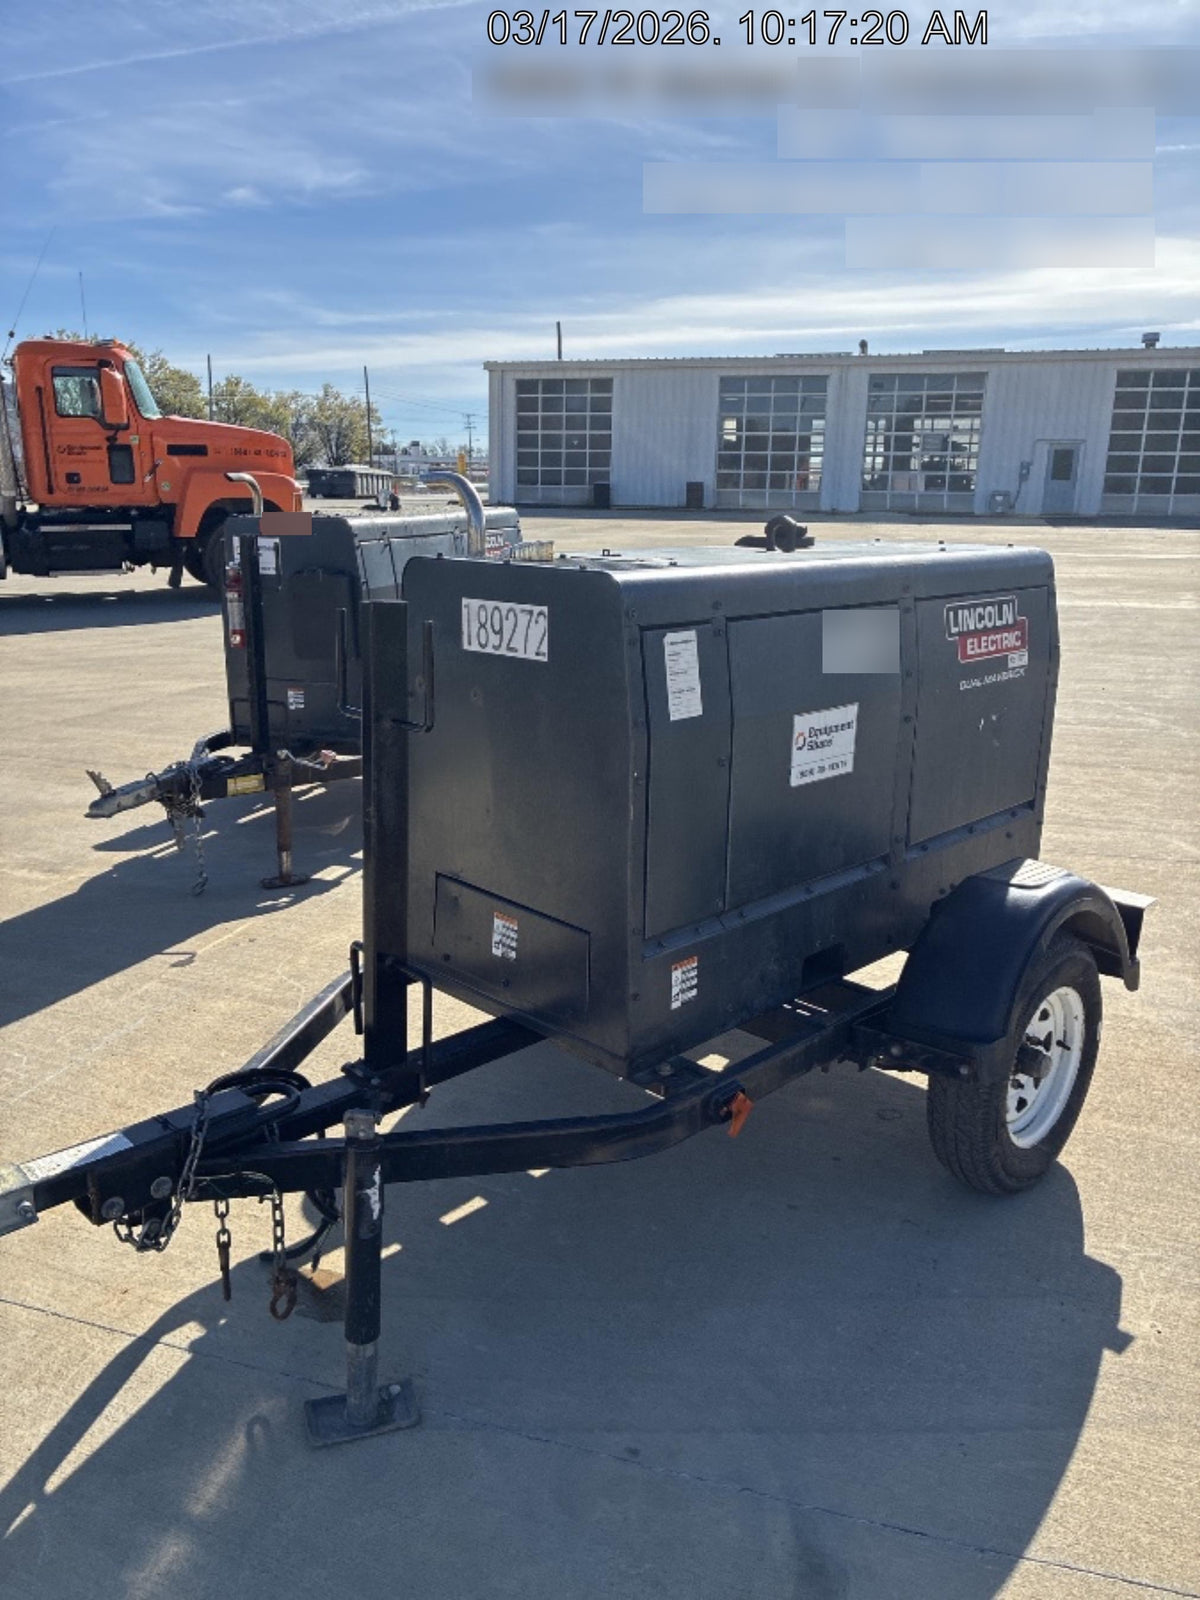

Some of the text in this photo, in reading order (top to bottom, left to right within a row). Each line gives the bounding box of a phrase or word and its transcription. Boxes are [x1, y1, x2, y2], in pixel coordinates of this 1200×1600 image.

[463, 602, 547, 657] 189272
[949, 602, 1014, 633] LINCOLN
[966, 631, 1022, 655] ELECTRIC
[808, 719, 854, 739] Equipment
